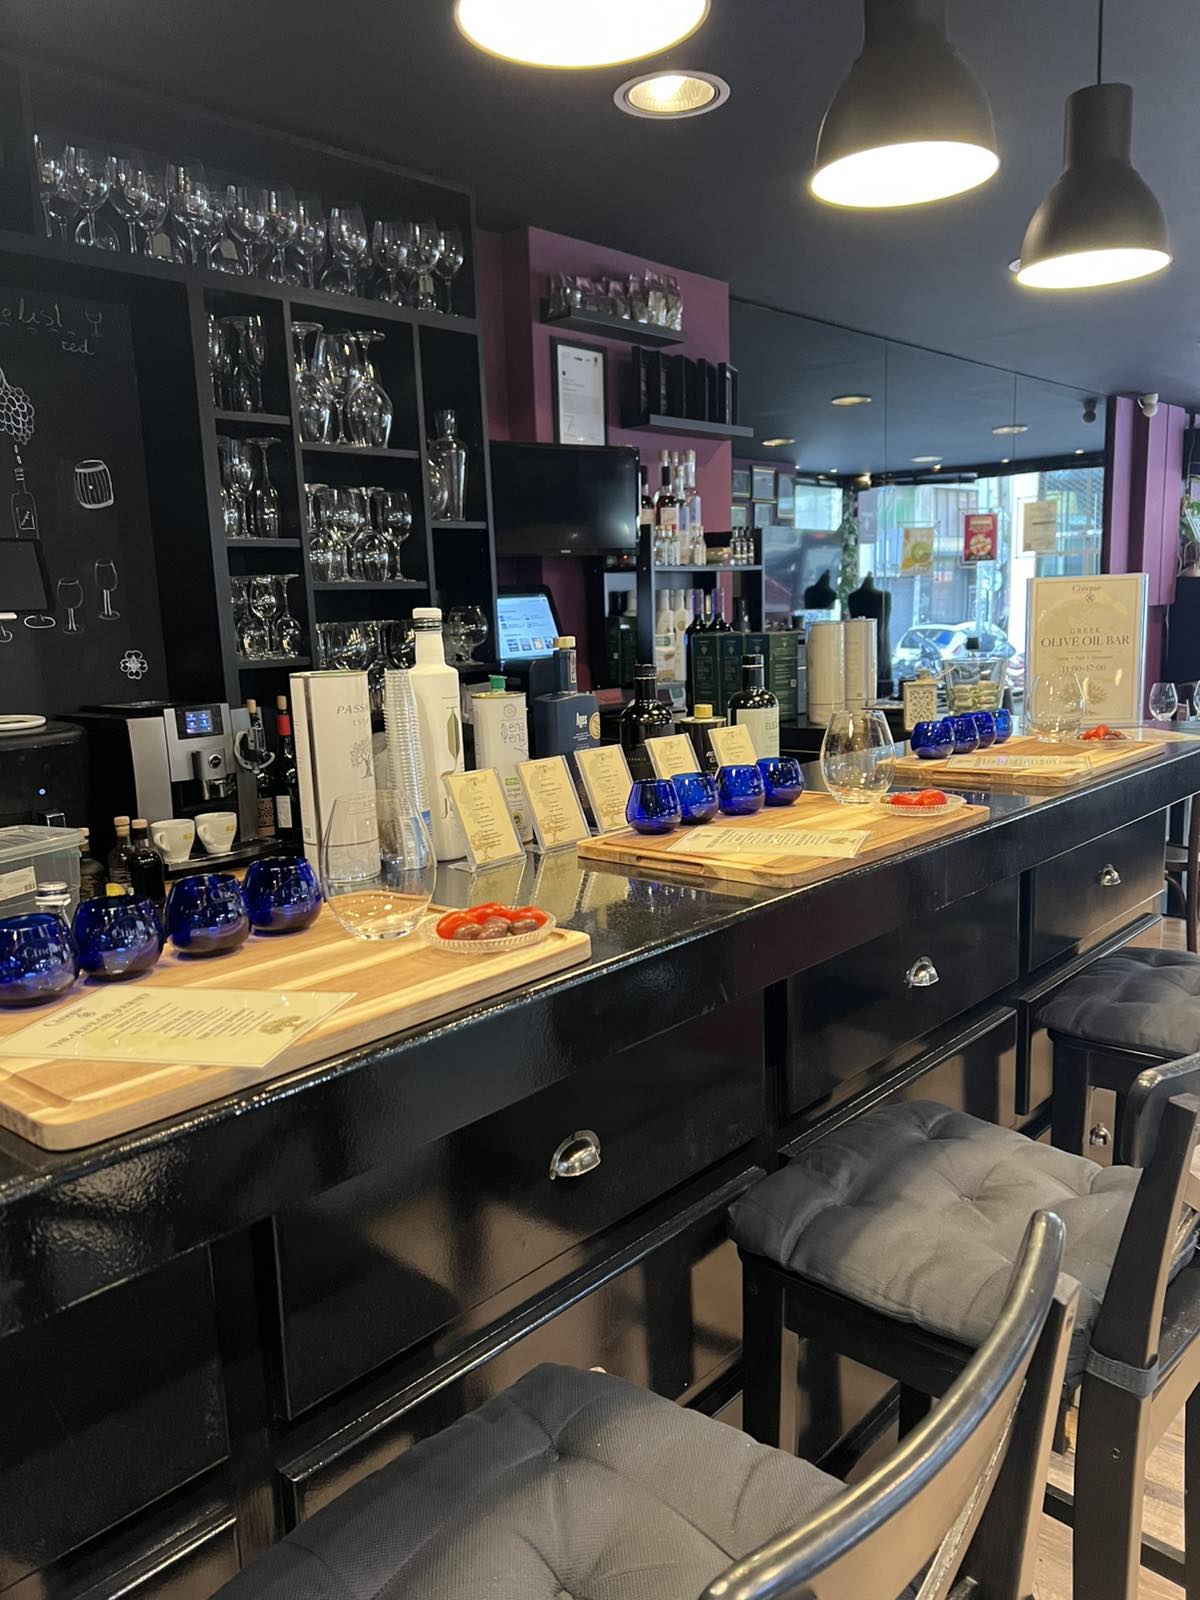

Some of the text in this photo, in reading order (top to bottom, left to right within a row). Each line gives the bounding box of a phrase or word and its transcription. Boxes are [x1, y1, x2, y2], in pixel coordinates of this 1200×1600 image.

[1070, 627, 1102, 635] GREEK
[1041, 634, 1130, 648] OLIVE OIL BAR
